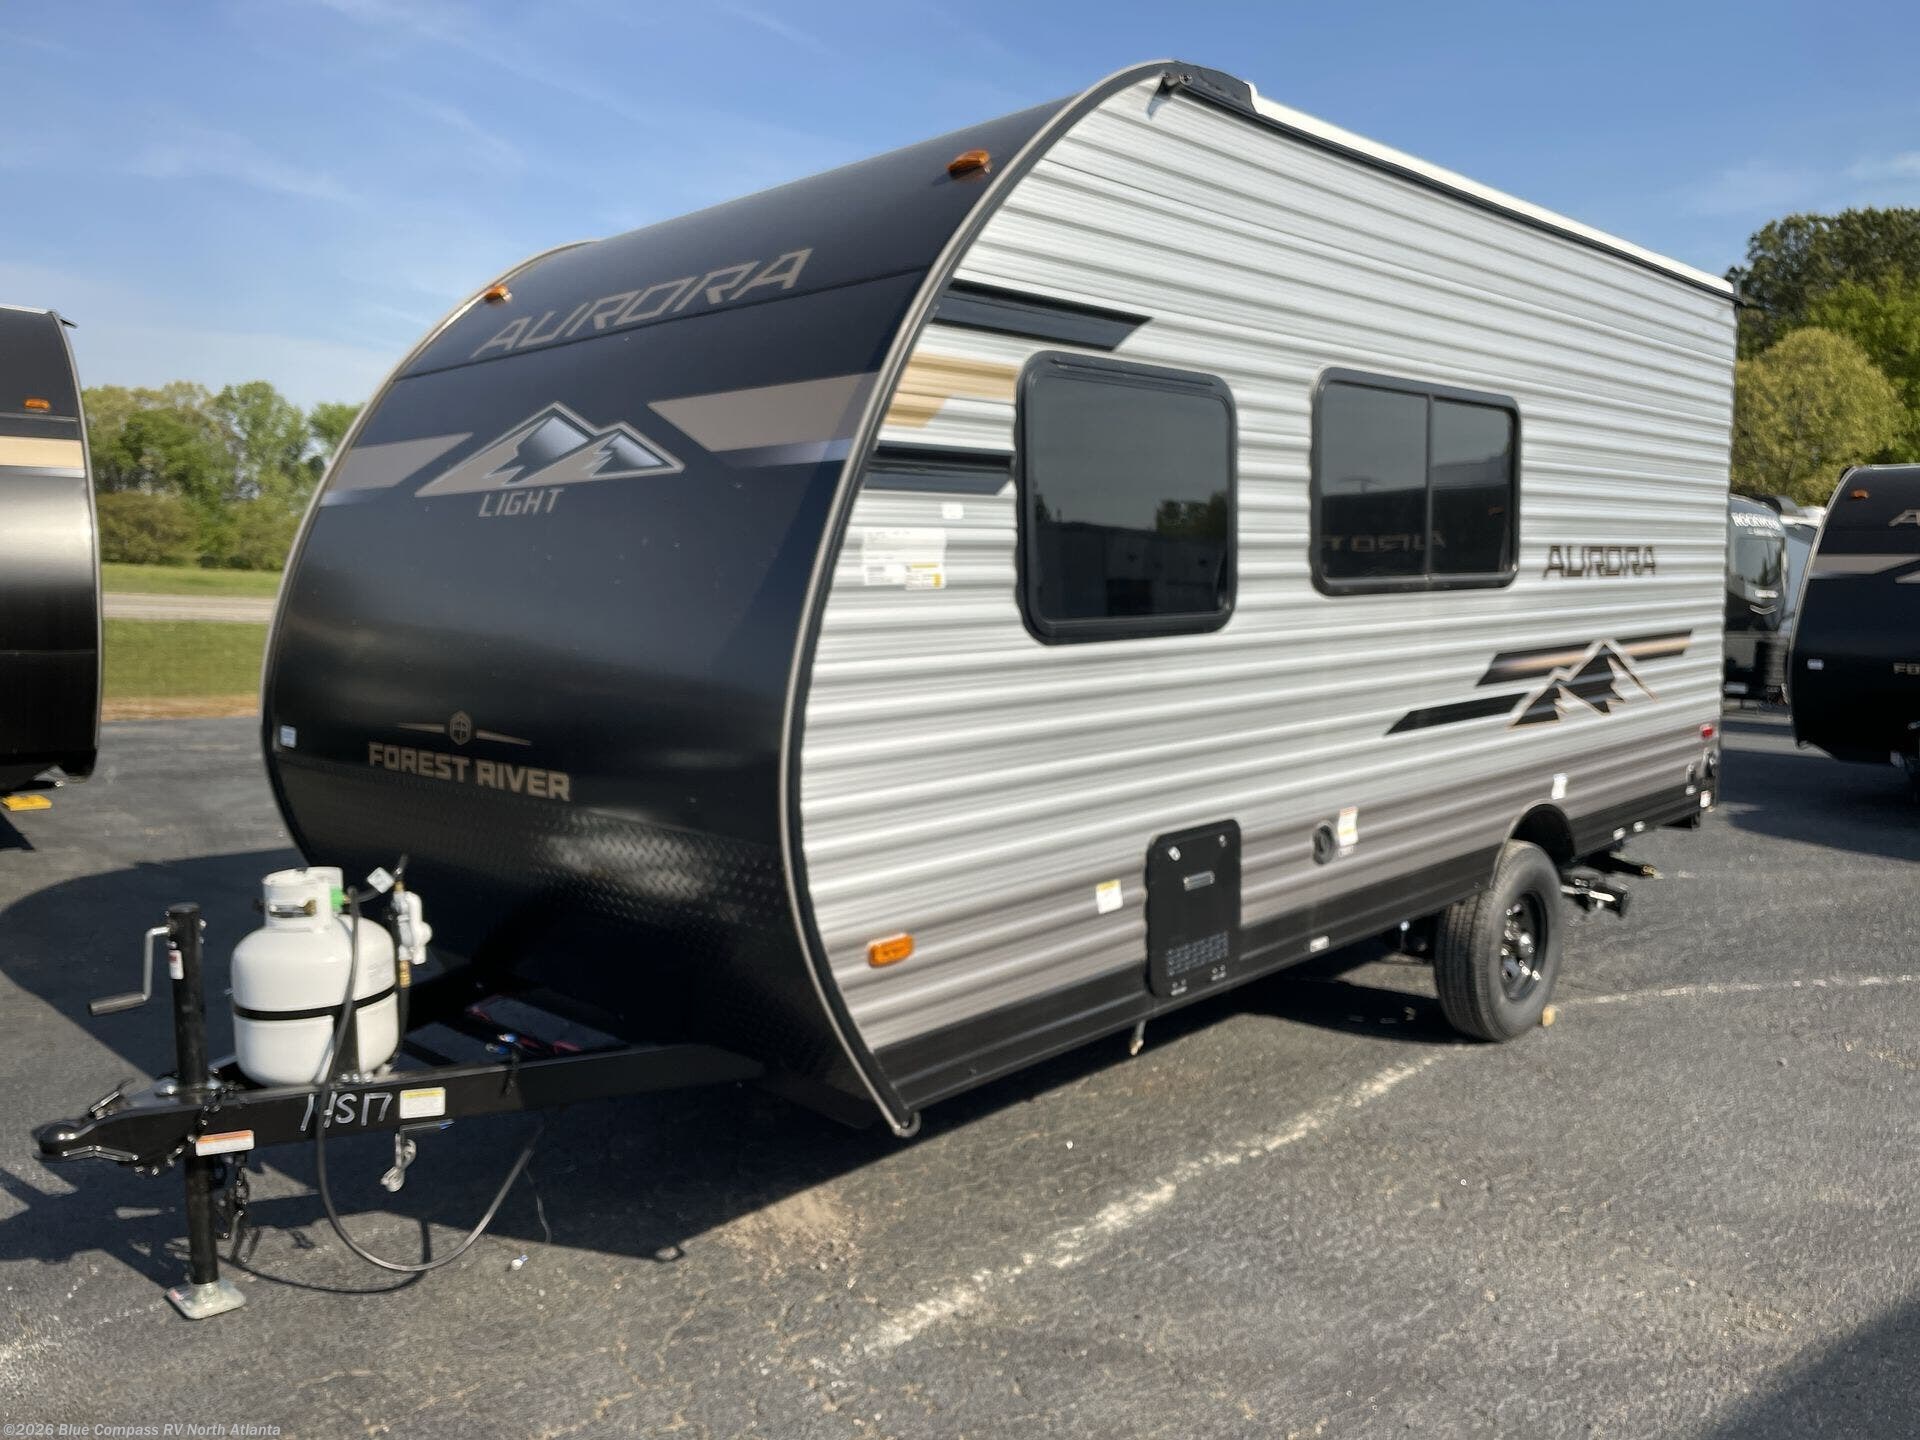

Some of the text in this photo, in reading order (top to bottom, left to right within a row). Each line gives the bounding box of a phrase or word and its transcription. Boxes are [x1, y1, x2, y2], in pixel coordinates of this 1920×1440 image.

[470, 247, 814, 359] AURORA
[478, 488, 564, 518] LIGHT
[1542, 545, 1656, 578] AURORA
[368, 741, 571, 801] FOREST RIVER
